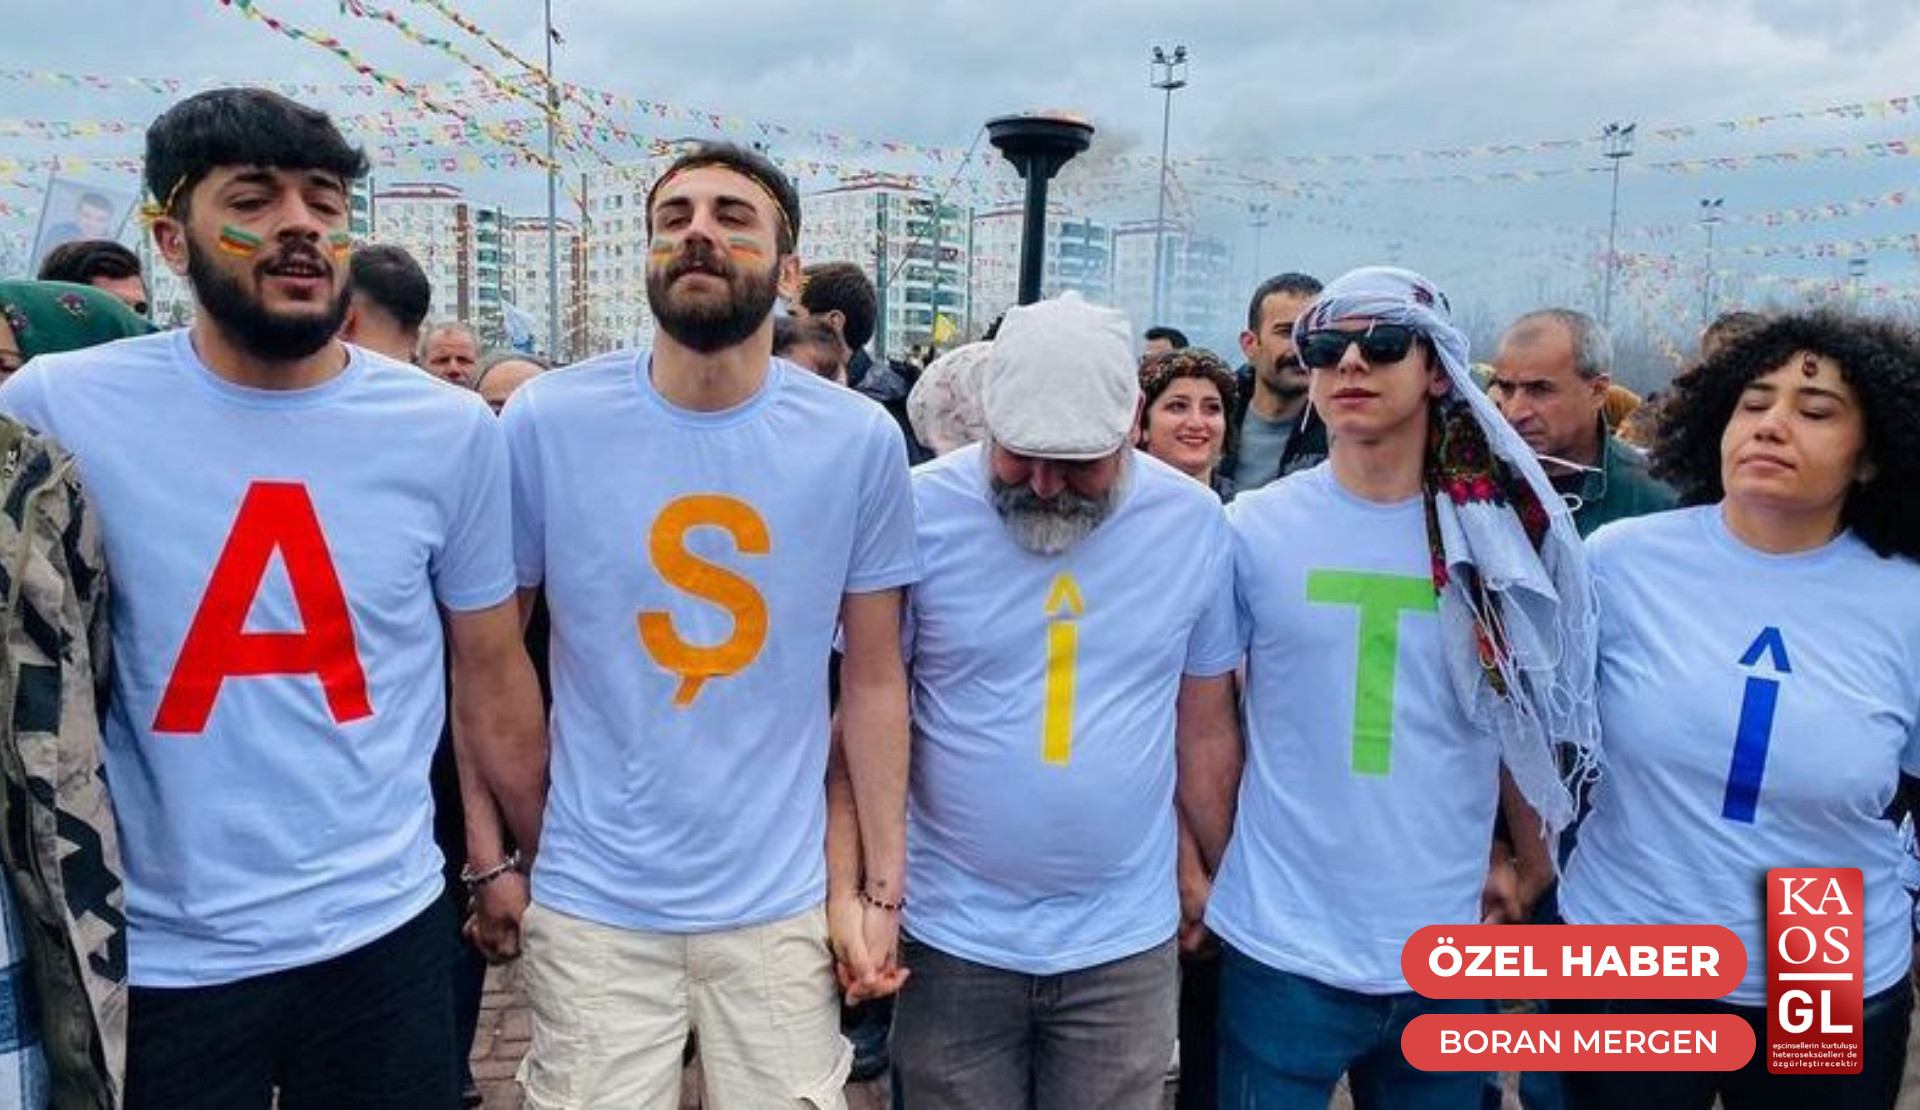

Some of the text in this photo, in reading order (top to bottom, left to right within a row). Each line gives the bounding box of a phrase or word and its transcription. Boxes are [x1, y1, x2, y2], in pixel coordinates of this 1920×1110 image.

[152, 481, 372, 734] A
[636, 493, 771, 706] Ş
[1306, 569, 1439, 777] T
